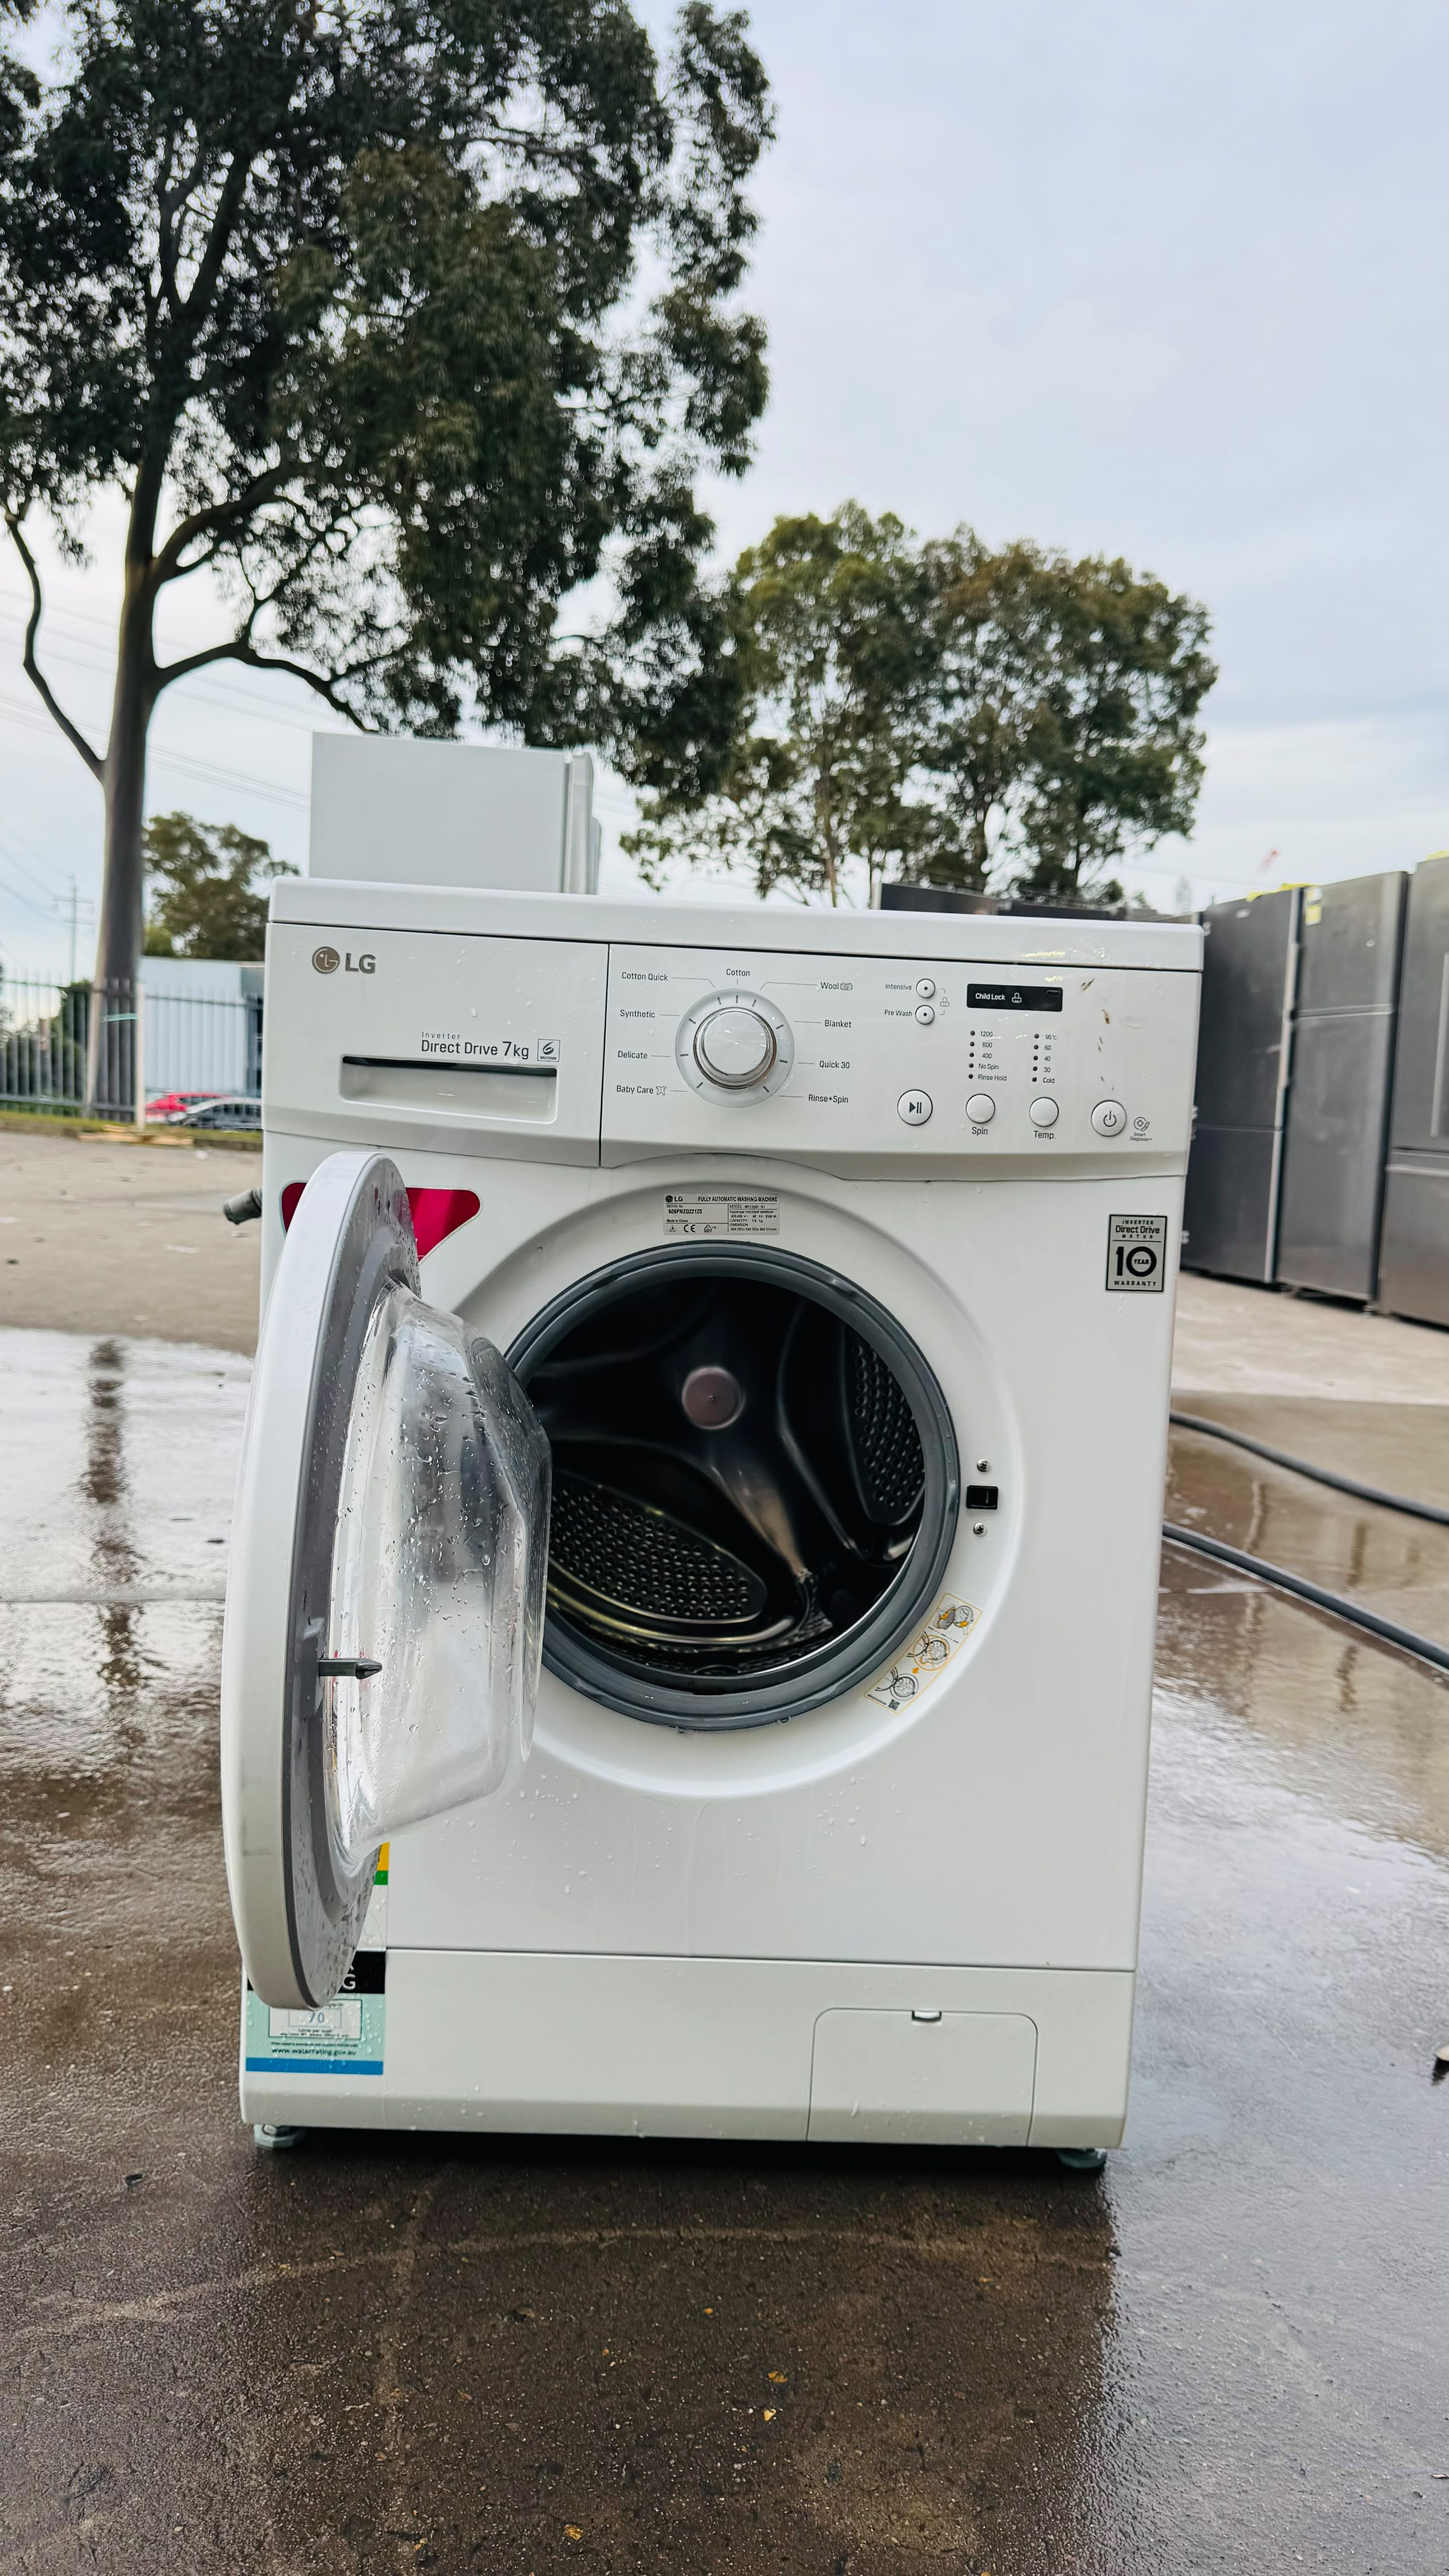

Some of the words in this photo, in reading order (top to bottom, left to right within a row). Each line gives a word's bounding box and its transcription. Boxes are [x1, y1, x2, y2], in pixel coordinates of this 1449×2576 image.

[345, 952, 376, 974] LG
[622, 972, 646, 980] Cotton
[726, 969, 750, 977] Cotton
[821, 982, 839, 990] Wool
[620, 1009, 656, 1018] Synthetic
[825, 1019, 852, 1028] Blanket
[422, 1031, 460, 1039] Inverter
[422, 1040, 460, 1054] Direct
[464, 1042, 498, 1056] Drive
[618, 1051, 648, 1059] Delicate
[820, 1060, 839, 1068] Quick
[617, 1085, 635, 1094] Baby
[637, 1086, 654, 1094] Care
[809, 1094, 848, 1104] Rinse+Spin
[972, 1126, 988, 1136] Spin
[1033, 1131, 1056, 1140] Temp.
[1115, 1225, 1139, 1233] Direct
[1140, 1226, 1160, 1234] Drive
[1116, 1246, 1157, 1277] 10
[309, 2012, 325, 2023] 70
